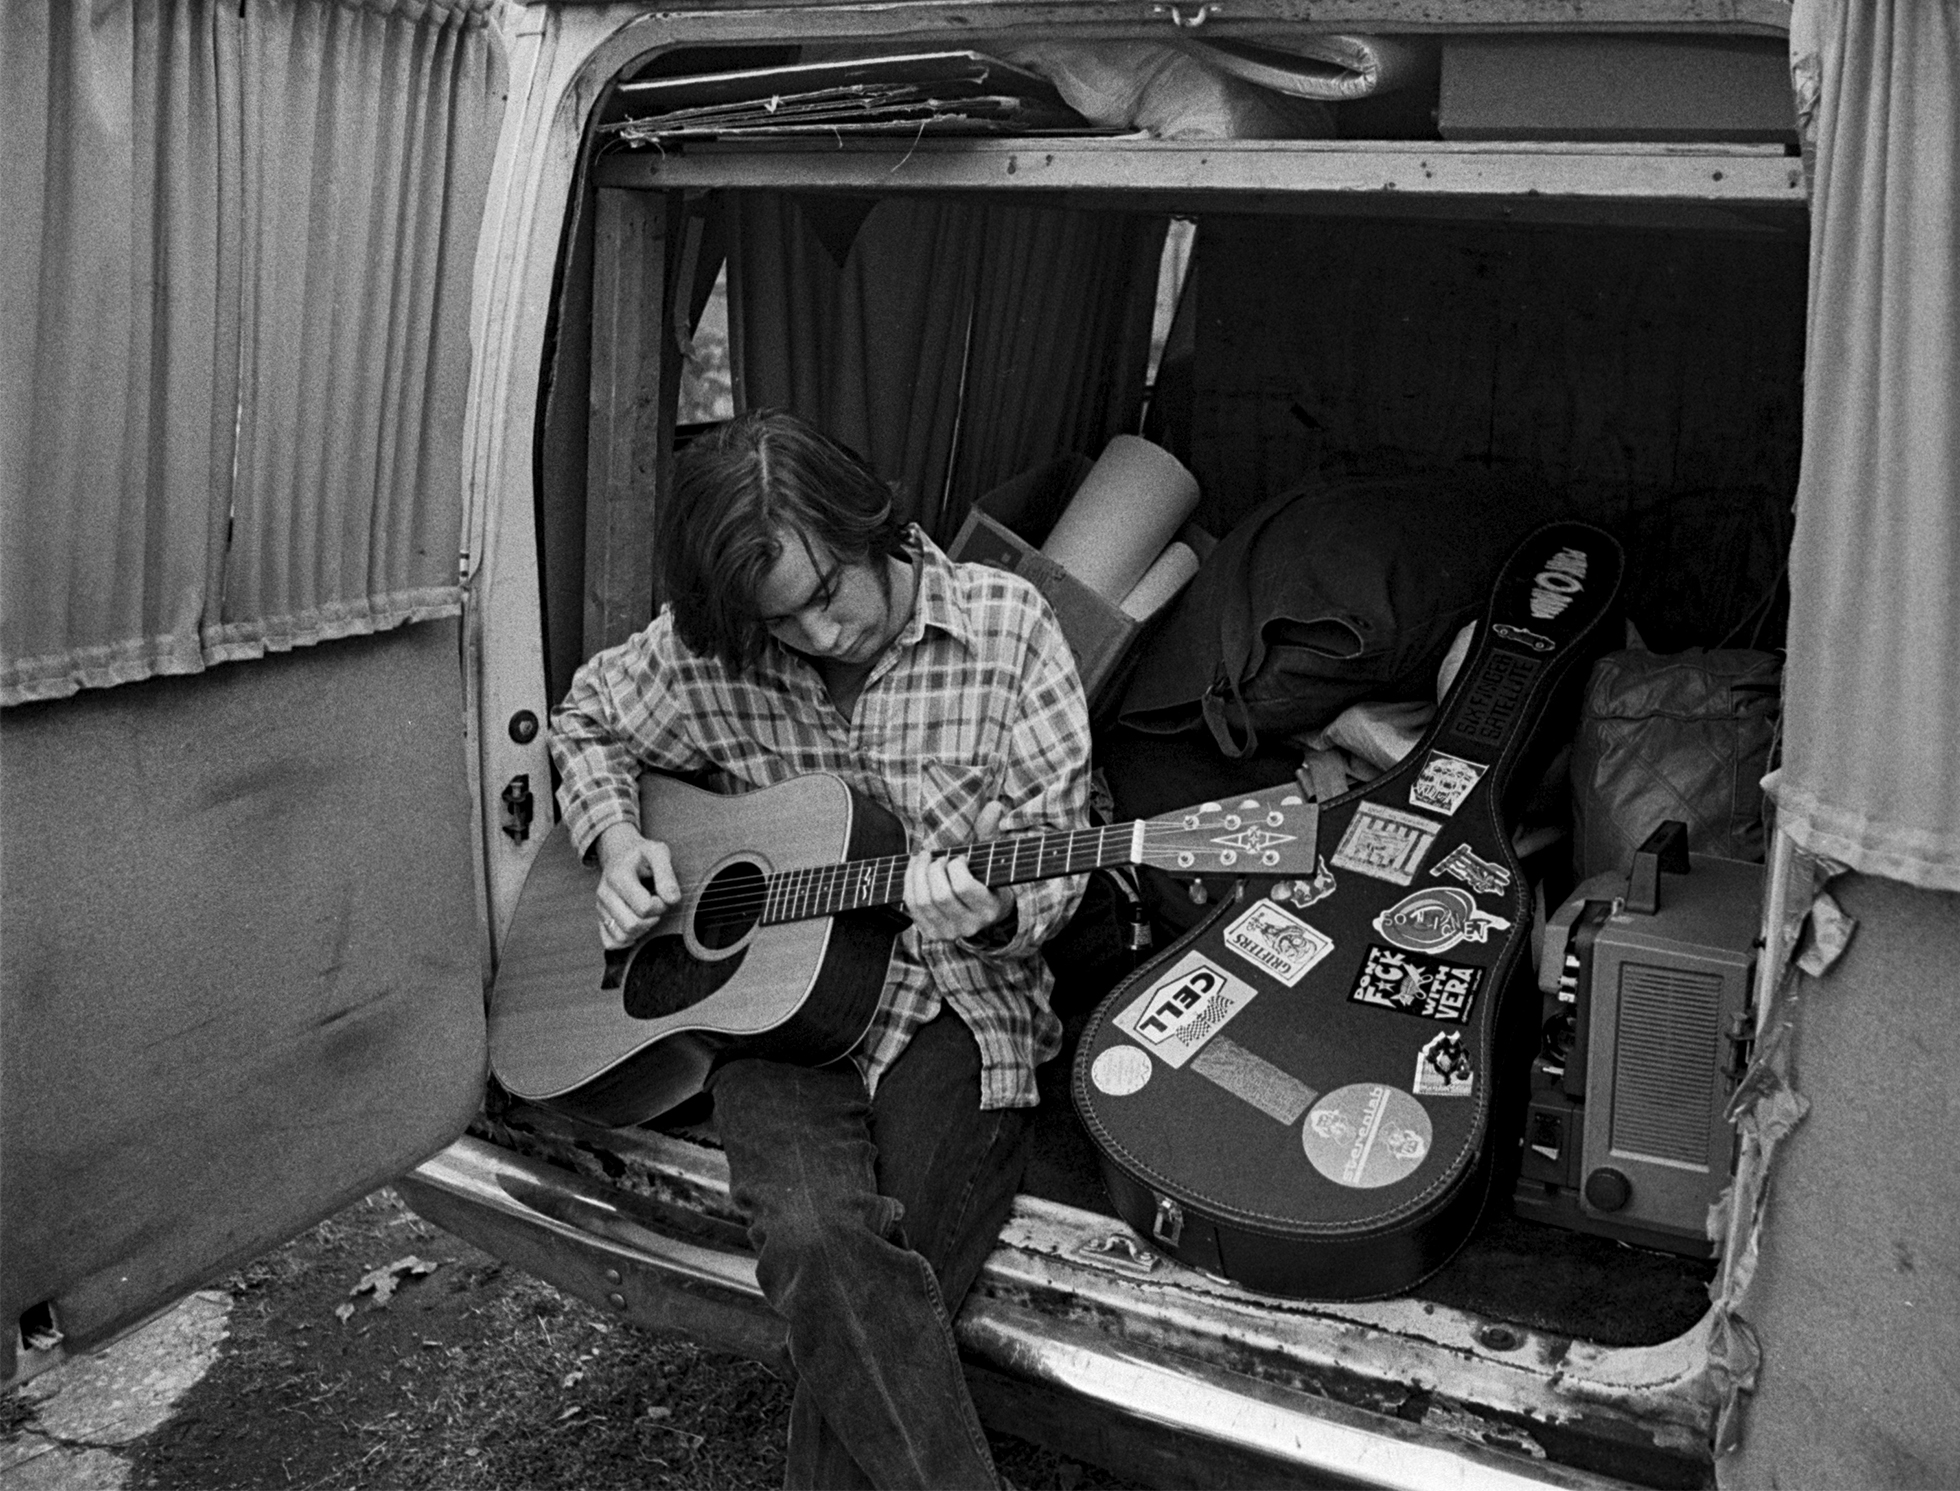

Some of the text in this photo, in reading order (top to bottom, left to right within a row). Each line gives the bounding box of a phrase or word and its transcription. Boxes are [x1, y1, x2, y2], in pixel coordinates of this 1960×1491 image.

[1456, 653, 1513, 735] SIX FINGER
[1481, 661, 1534, 740] SATELLITE
[1233, 933, 1292, 974] GRIFTERS
[1139, 972, 1215, 1033] CELL
[1421, 965, 1450, 1015] WITH
[1434, 968, 1474, 1019] VERA
[1342, 1087, 1383, 1182] stereolab
